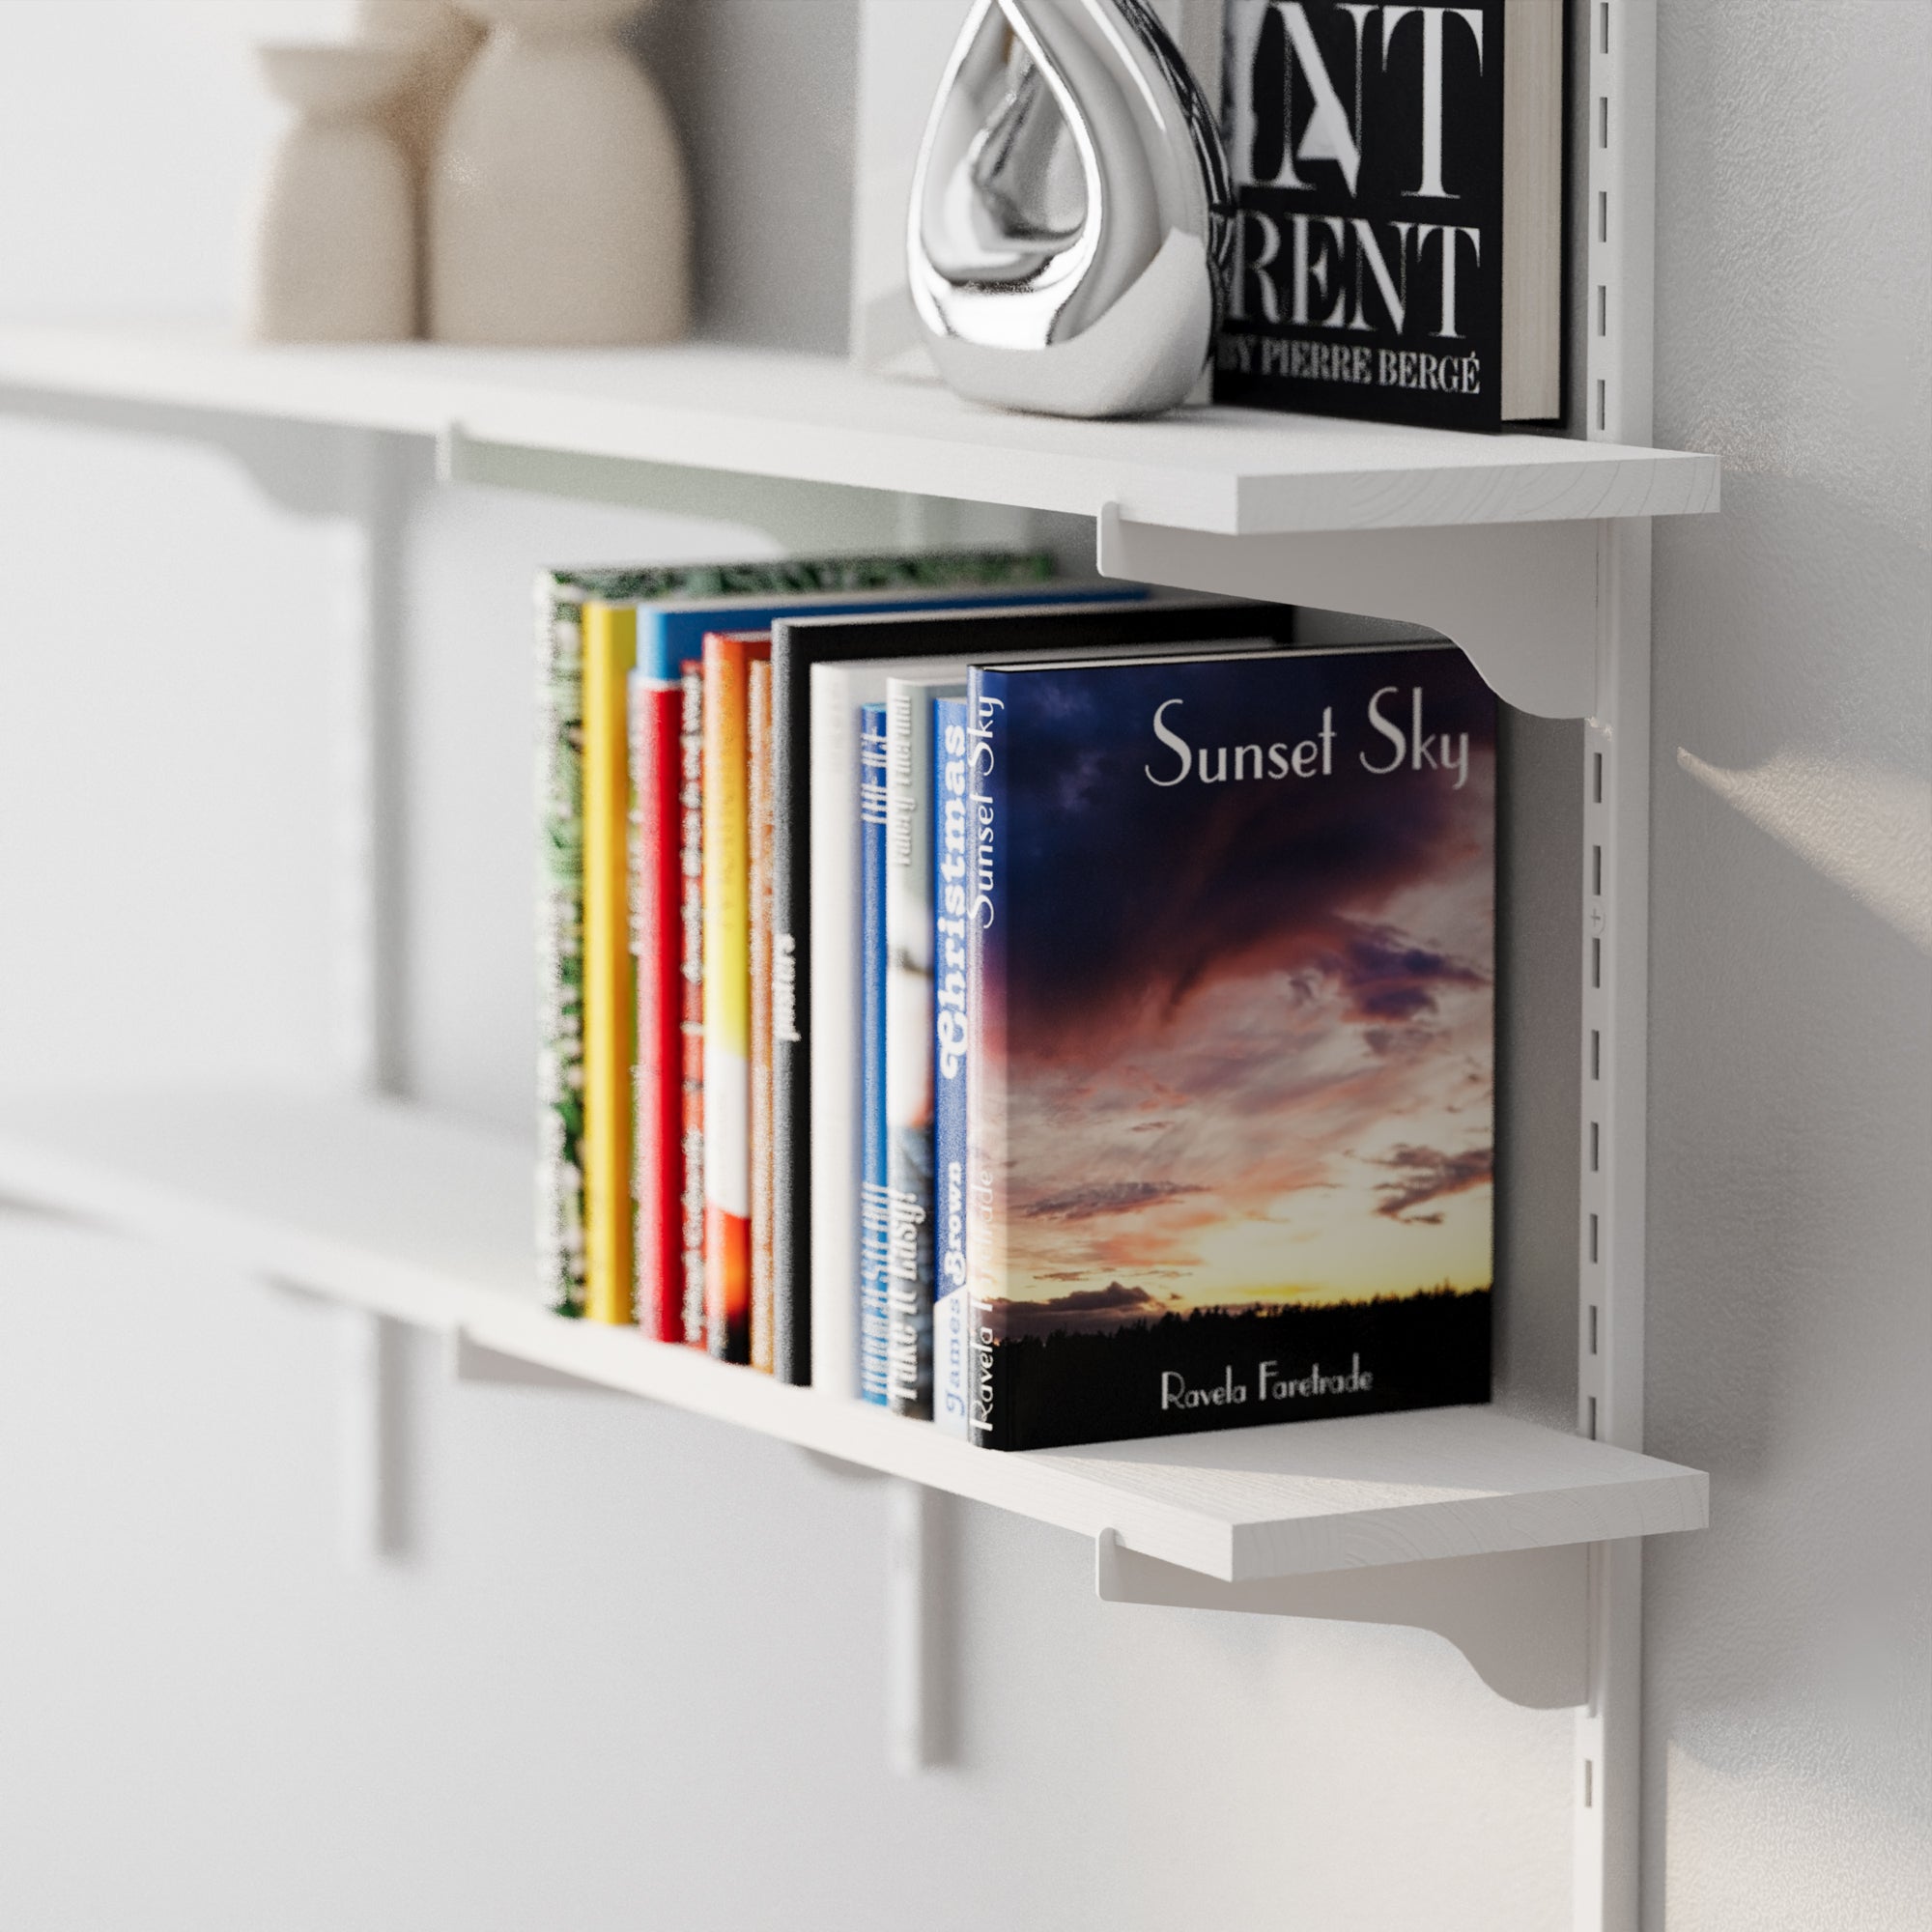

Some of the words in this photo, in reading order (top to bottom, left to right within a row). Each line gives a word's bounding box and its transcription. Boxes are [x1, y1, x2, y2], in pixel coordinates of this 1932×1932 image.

[1261, 337, 1373, 384] PIERRE
[1378, 350, 1480, 394] BERGÉ
[967, 696, 1005, 777] Sky
[1145, 697, 1337, 786] Sunset
[1359, 686, 1469, 790] Sky
[938, 724, 967, 1080] Christmas
[944, 1161, 966, 1287] Brown
[887, 1321, 918, 1401] Take
[945, 1297, 965, 1418] James
[968, 1326, 994, 1432] Ravela
[1161, 1365, 1246, 1409] Ravela
[1259, 1352, 1374, 1401] Faretrade
